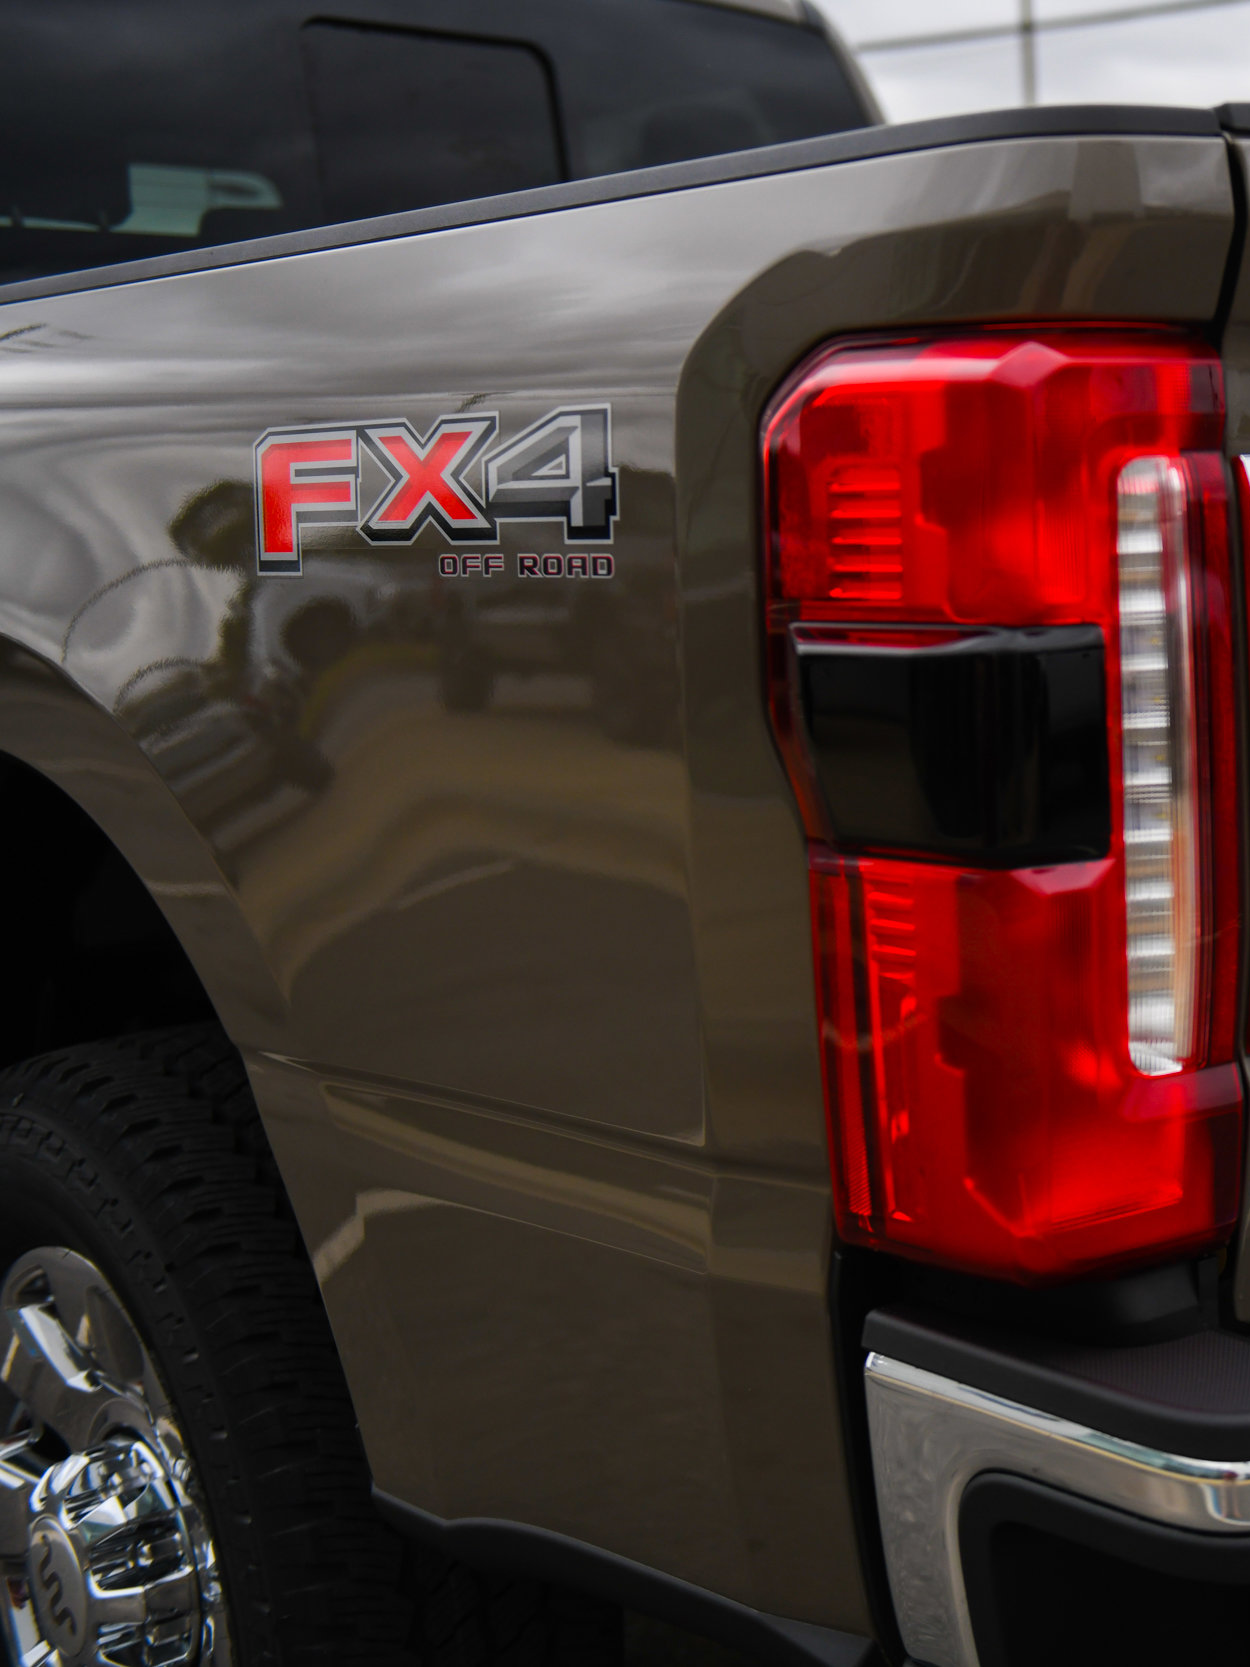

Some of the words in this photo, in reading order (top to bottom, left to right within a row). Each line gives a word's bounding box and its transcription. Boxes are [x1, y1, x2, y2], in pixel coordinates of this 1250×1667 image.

[253, 403, 620, 577] FX4
[439, 552, 504, 578] OFF
[518, 552, 615, 578] ROAD
